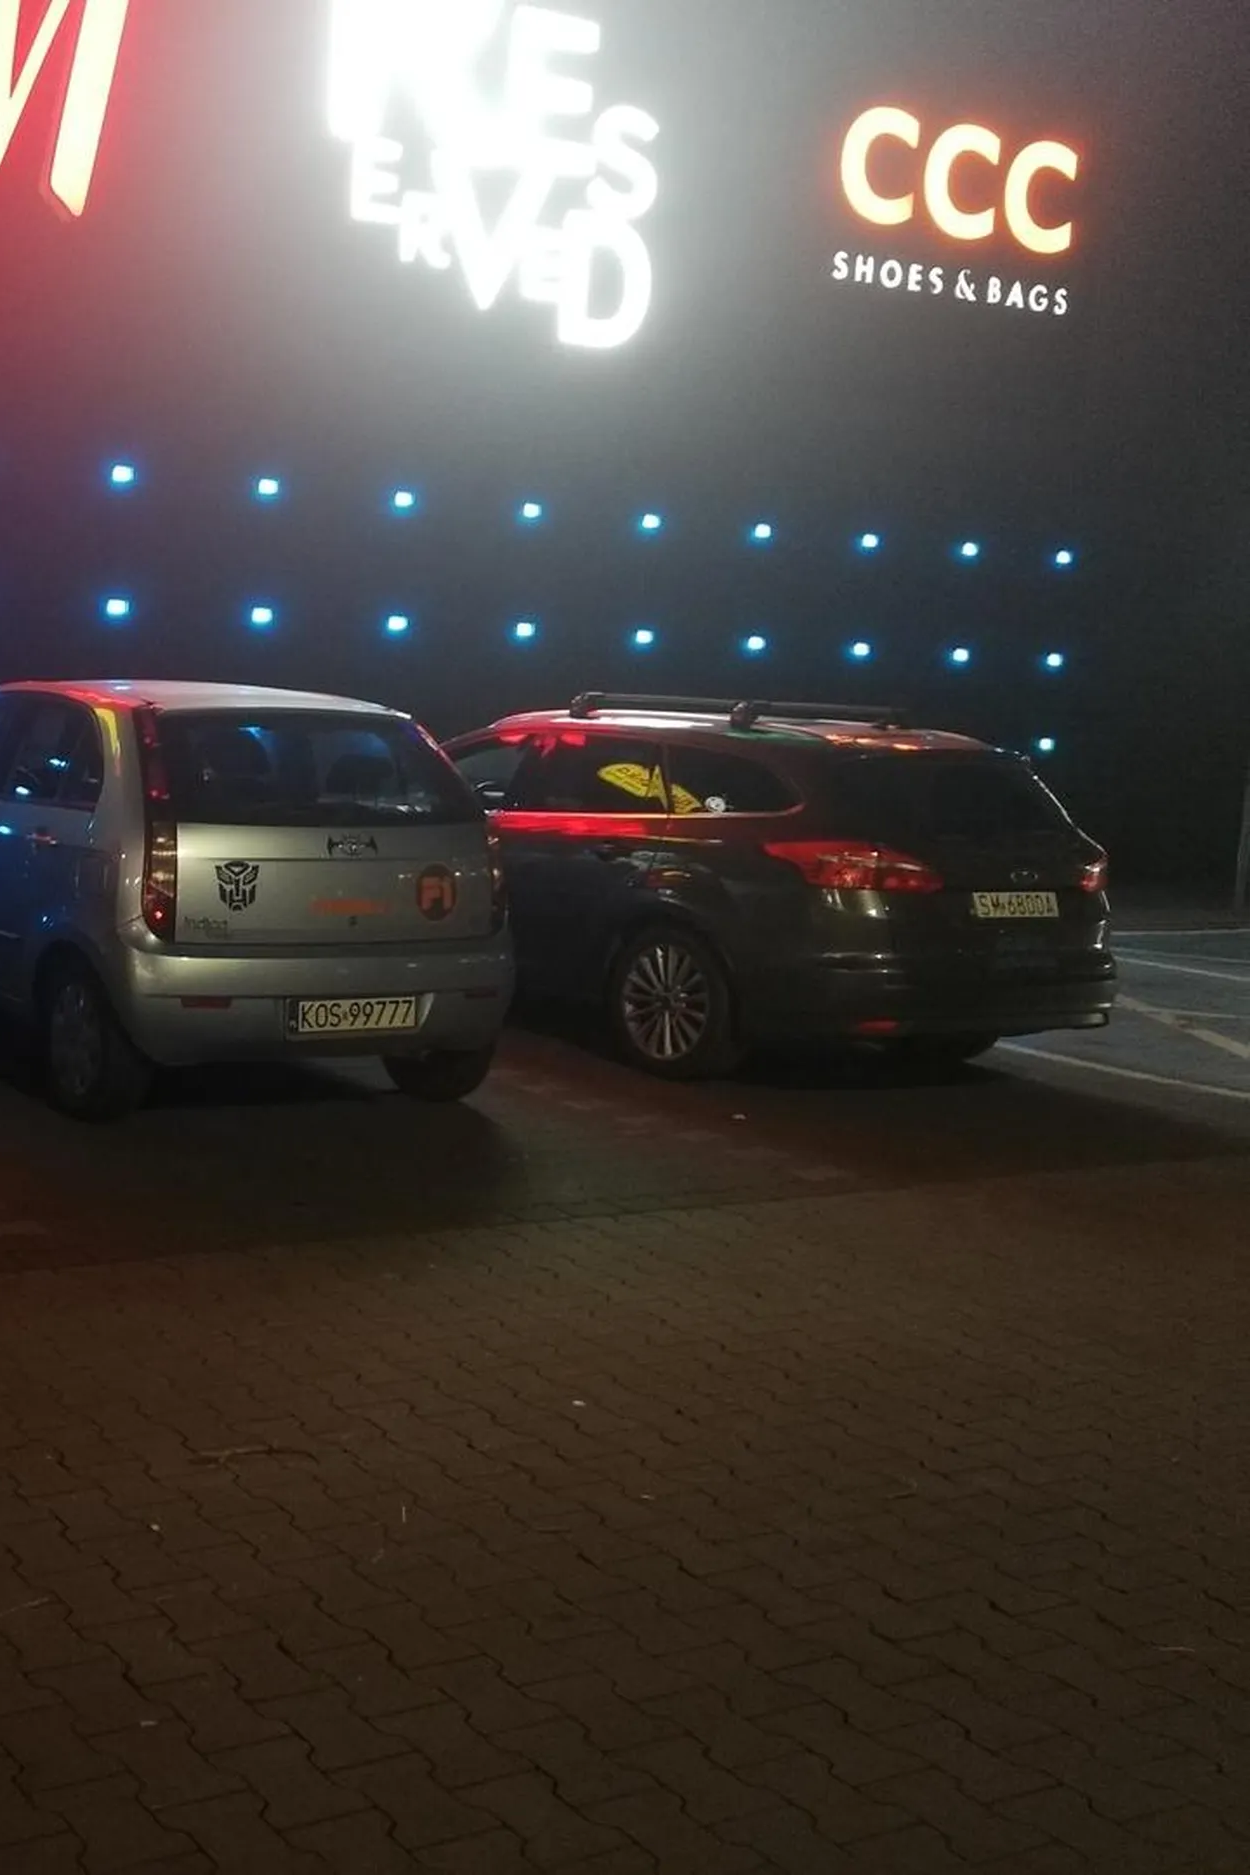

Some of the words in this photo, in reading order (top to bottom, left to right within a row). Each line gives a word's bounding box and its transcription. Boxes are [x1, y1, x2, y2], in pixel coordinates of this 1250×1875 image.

[840, 105, 1079, 254] CCC
[831, 250, 944, 295] SHOES
[954, 269, 977, 302] &
[986, 276, 1069, 316] BAGS
